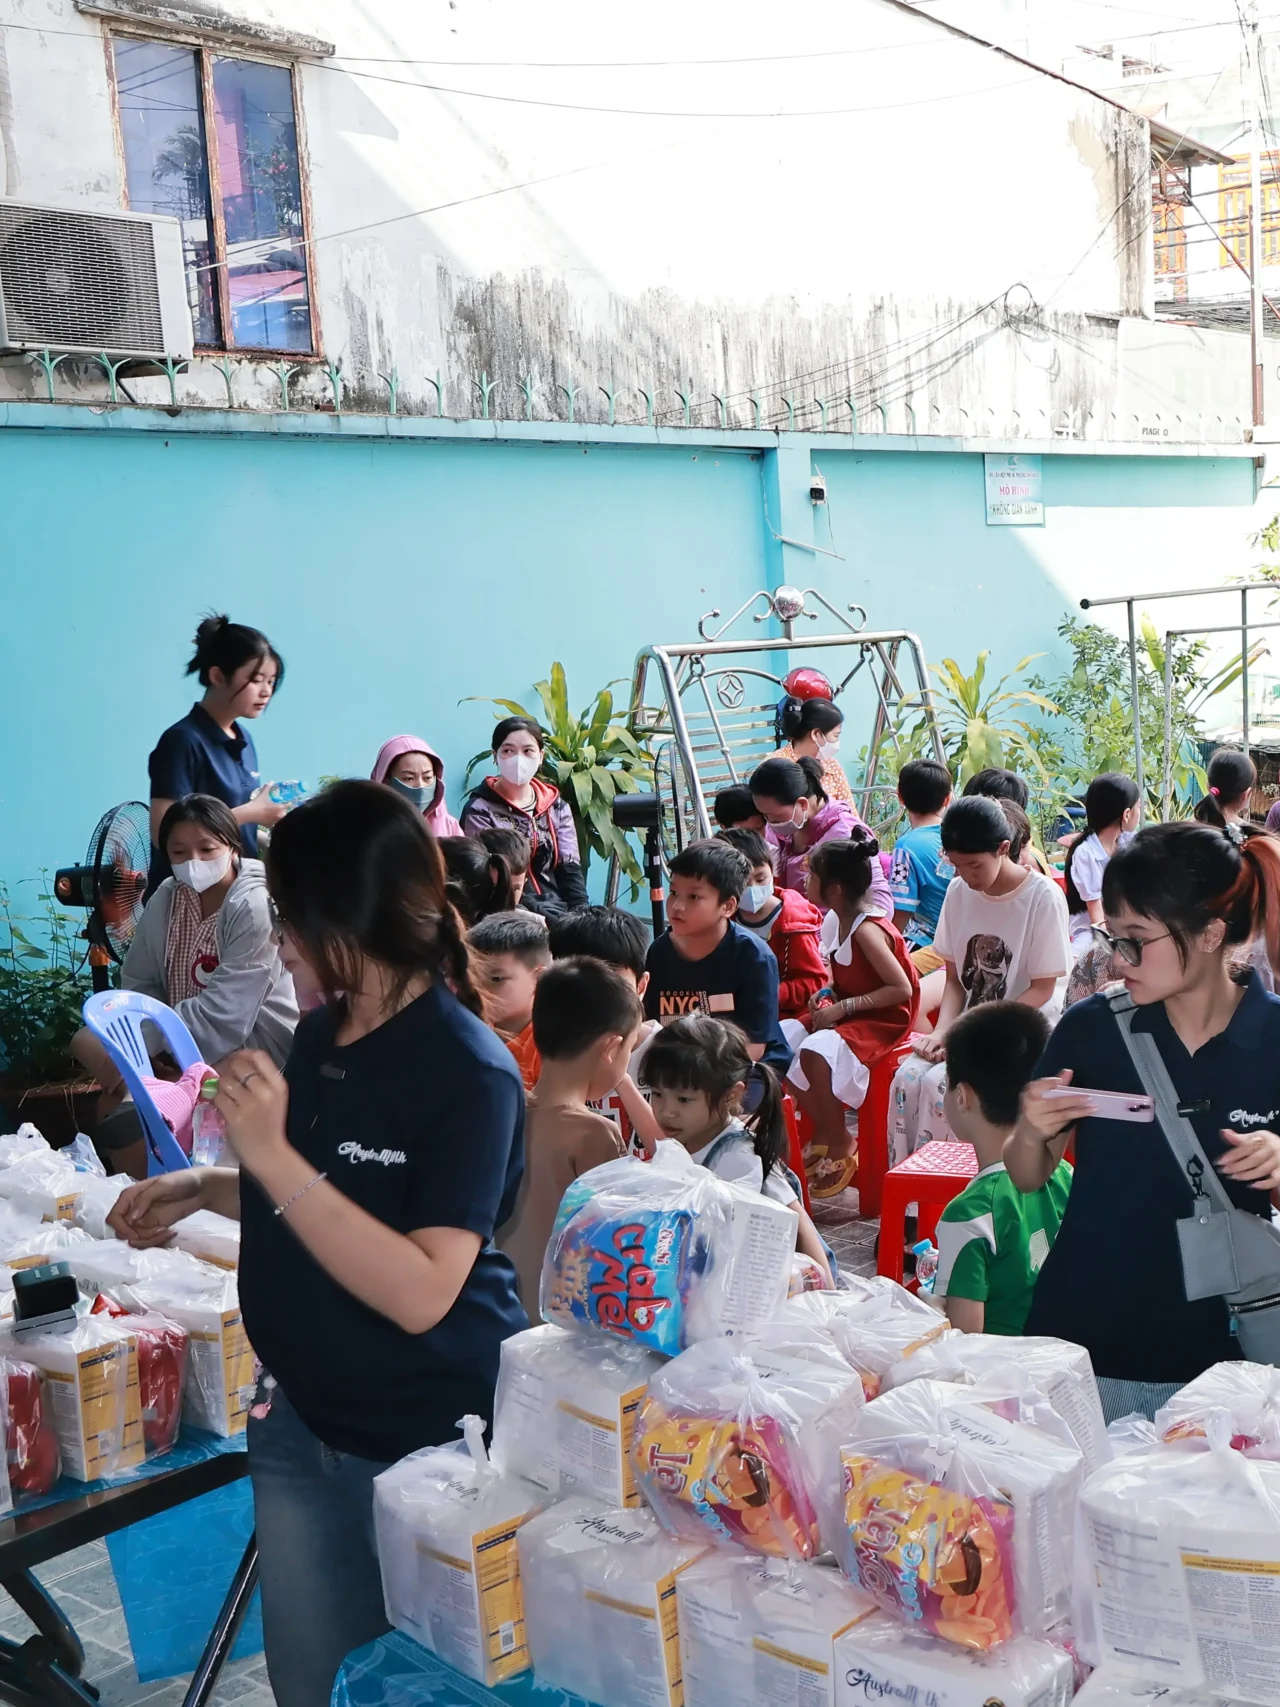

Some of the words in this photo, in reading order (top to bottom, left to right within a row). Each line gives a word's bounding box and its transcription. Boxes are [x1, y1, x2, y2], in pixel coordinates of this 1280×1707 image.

[1141, 427, 1168, 436] PIAGO
[660, 996, 699, 1015] NYC
[612, 1223, 672, 1331] Crab
